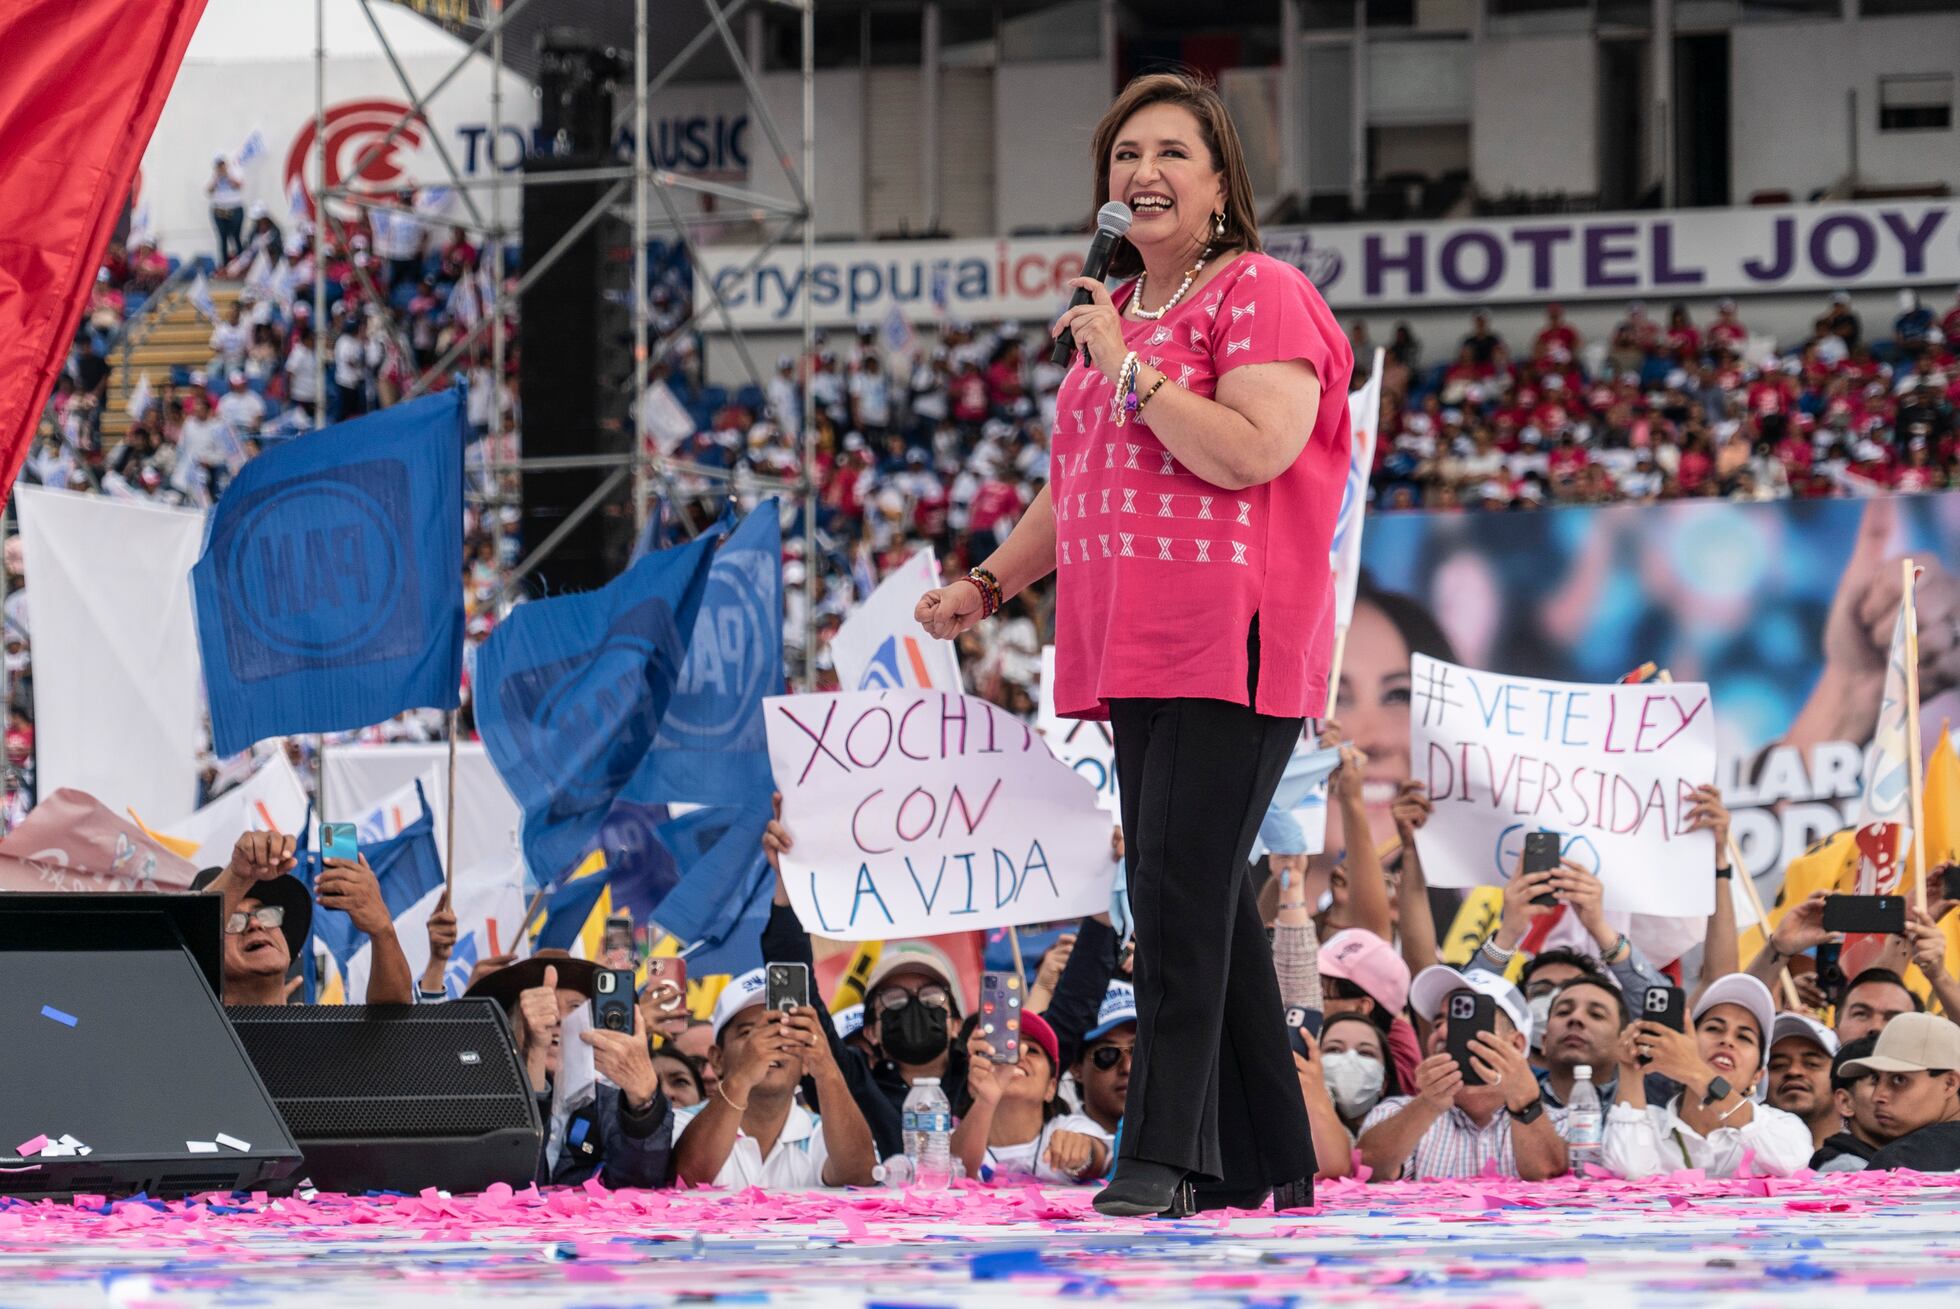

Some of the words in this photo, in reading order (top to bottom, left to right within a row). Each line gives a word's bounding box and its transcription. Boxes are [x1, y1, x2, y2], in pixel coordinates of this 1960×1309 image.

[1362, 221, 1706, 297] HOTEL
[1743, 208, 1948, 283] JOY
[852, 778, 1002, 854] CON
[1427, 741, 1698, 842] DIVERSIDAD
[810, 862, 895, 932] LA
[904, 838, 1060, 916] VIDA
